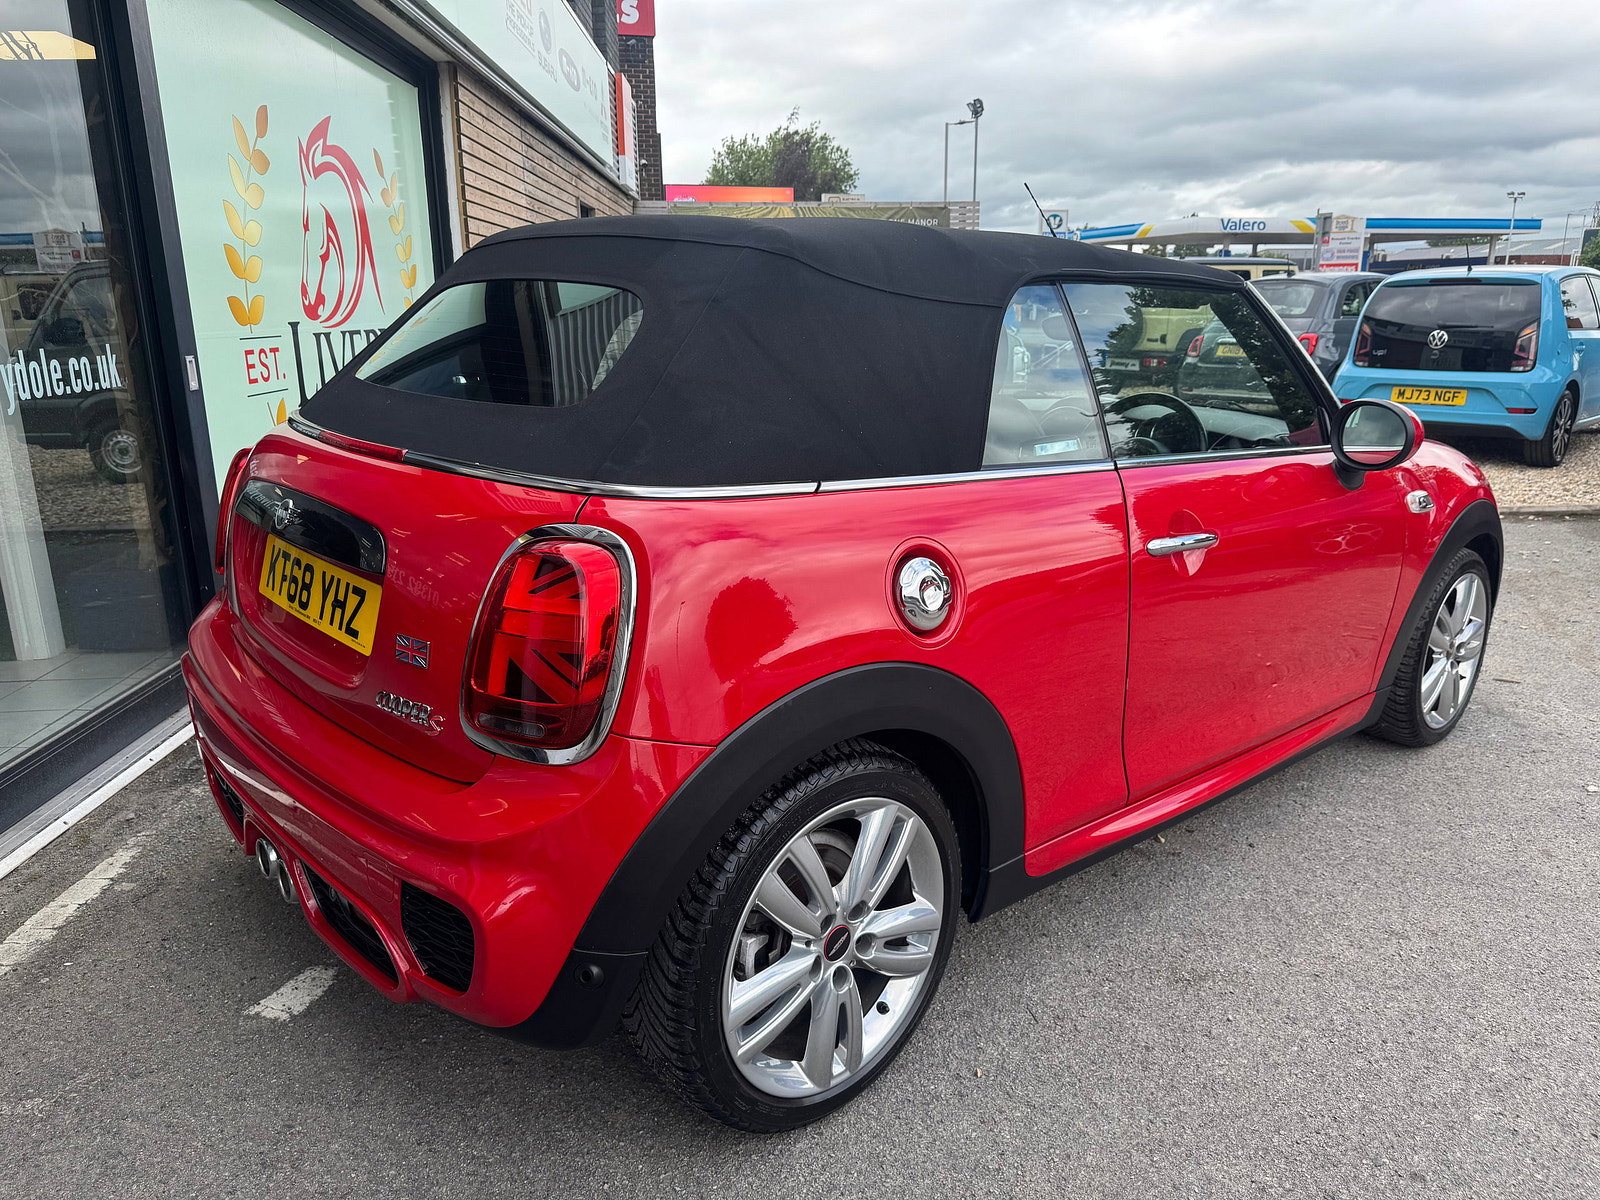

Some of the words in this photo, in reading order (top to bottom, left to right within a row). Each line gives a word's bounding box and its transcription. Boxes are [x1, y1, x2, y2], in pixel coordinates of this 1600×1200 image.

[616, 0, 640, 24] S
[907, 218, 939, 227] MANOR
[1220, 218, 1266, 231] Valero
[244, 347, 287, 385] EST.
[1396, 389, 1431, 401] MJ73
[1433, 390, 1461, 403] NGF
[266, 544, 315, 612] KT68
[319, 570, 367, 640] YHZ
[375, 691, 432, 727] COOPER
[425, 715, 446, 736] S
